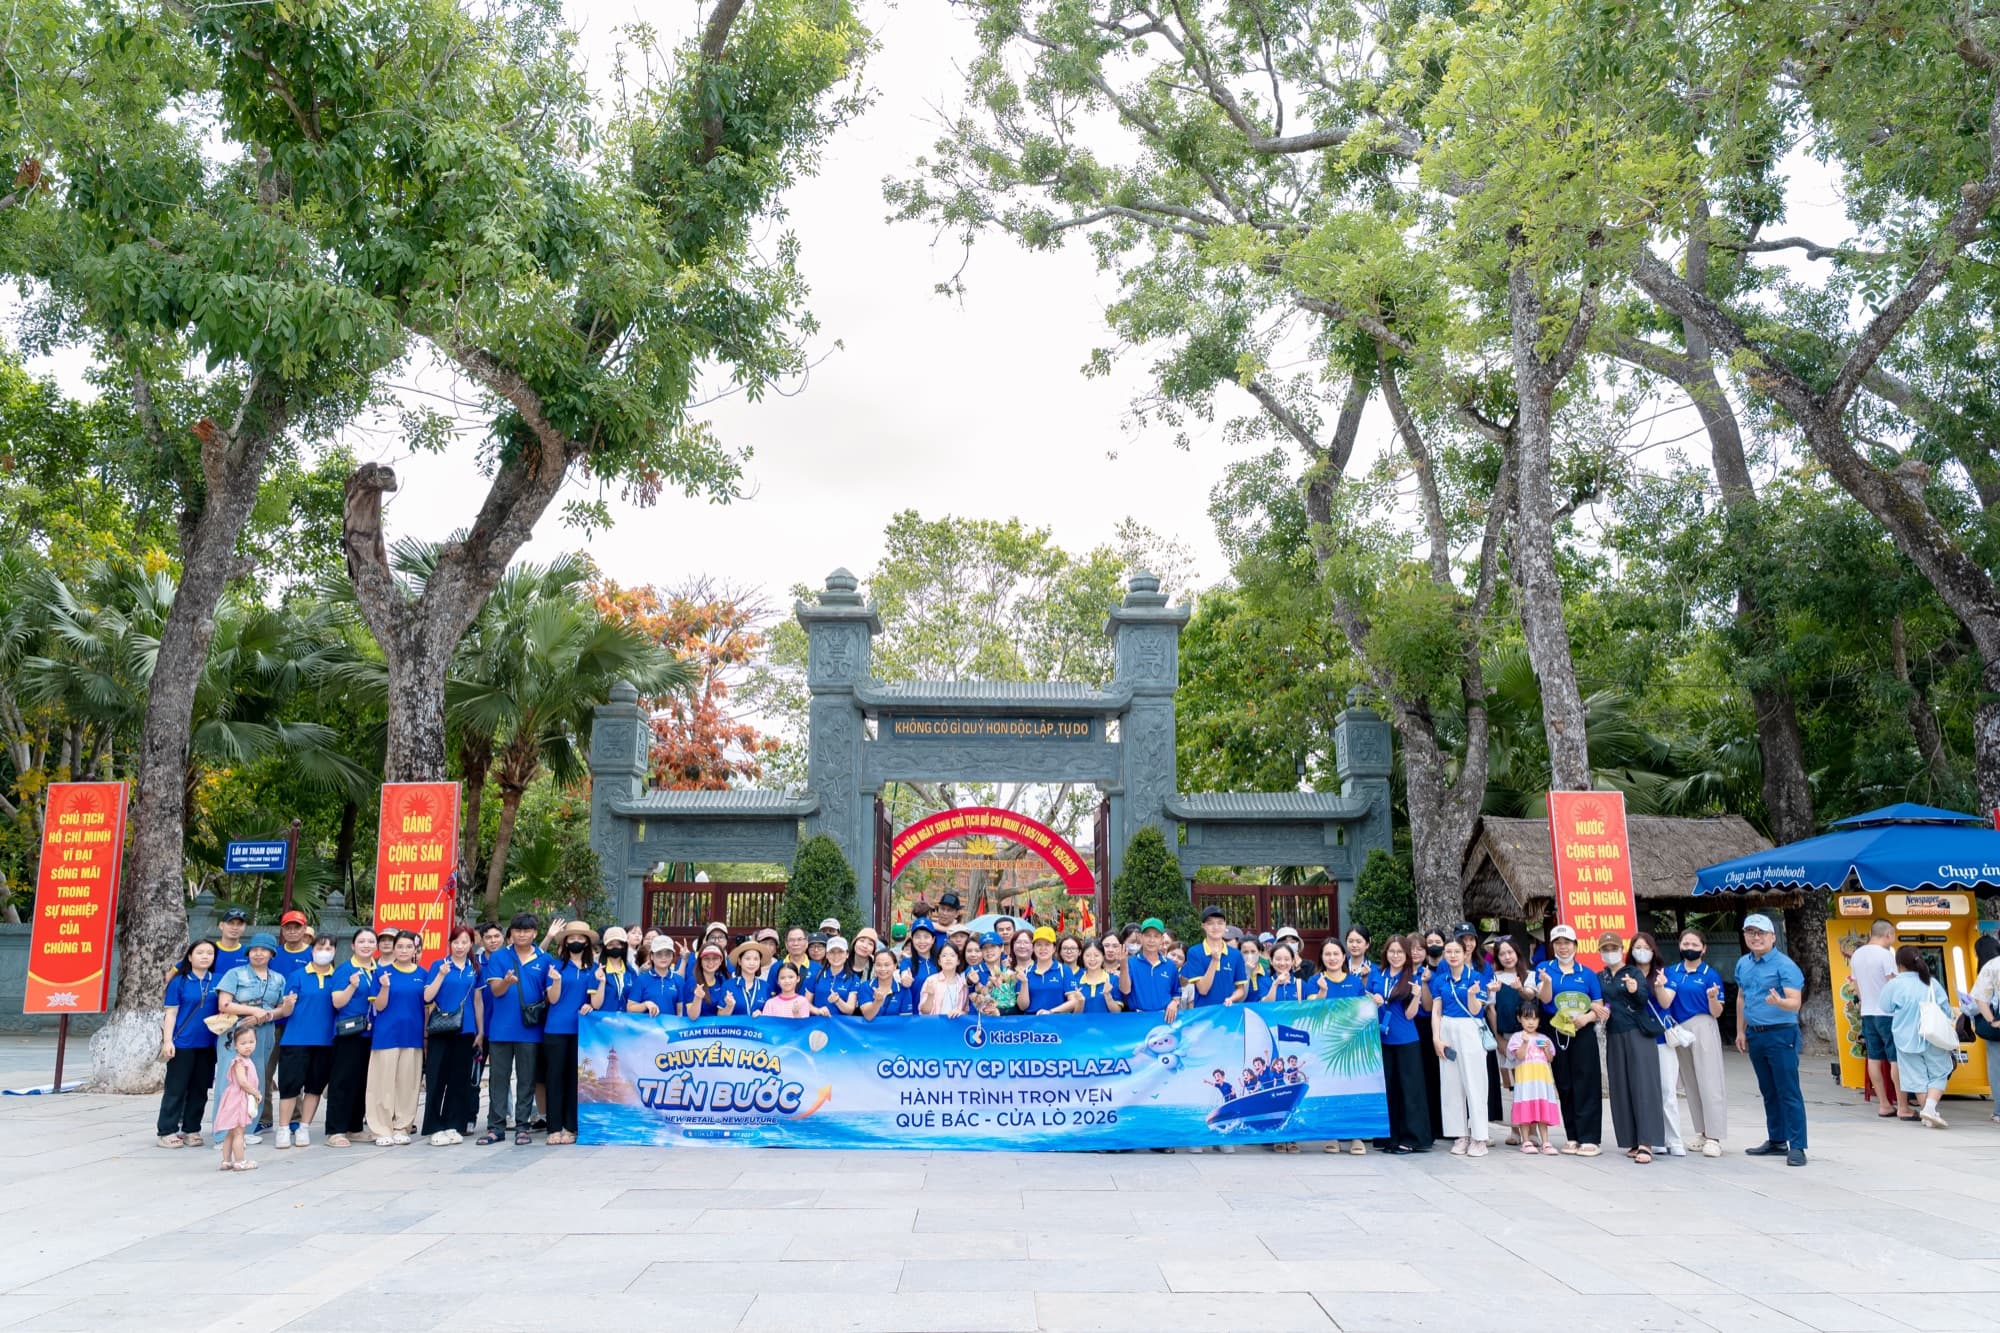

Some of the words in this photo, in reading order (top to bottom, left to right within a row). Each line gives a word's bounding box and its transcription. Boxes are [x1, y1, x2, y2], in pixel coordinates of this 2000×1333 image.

[895, 716, 932, 733] KHÔNG
[933, 717, 948, 734] CÓ
[950, 717, 961, 734] GÌ
[962, 718, 984, 734] QUÝ
[986, 722, 1008, 734] HƠN
[1010, 718, 1032, 738] ĐỘC
[1058, 722, 1072, 738] TỰ
[1073, 722, 1088, 735] DO
[59, 810, 80, 825] CHỦ
[82, 812, 104, 826] TỊCH
[402, 810, 432, 833] ĐẢNG
[1575, 818, 1605, 835] NƯỚC
[64, 829, 82, 843] CHÍ
[84, 830, 111, 843] MINH
[63, 848, 74, 861] VĨ
[75, 849, 92, 863] ĐẠI
[249, 847, 265, 855] THAM
[266, 847, 282, 855] QUAN
[388, 841, 418, 866] CỘNG
[420, 839, 443, 862] SẢN
[1566, 842, 1597, 861] CỘNG
[1598, 842, 1620, 859] HÒA
[50, 864, 78, 880] SỐNG
[80, 864, 100, 879] MÃI
[1577, 863, 1592, 882] XÃ
[1594, 865, 1613, 884] HỘI
[1725, 871, 1745, 883] Chụp
[1745, 866, 1761, 880] ảnh
[1762, 865, 1806, 880] photobooth
[1938, 864, 1979, 880] Chụp
[388, 870, 411, 895] VIỆT
[413, 873, 439, 891] NAM
[57, 886, 90, 898] TRONG
[1568, 887, 1591, 906] CHỦ
[1593, 888, 1627, 906] NGHĨA
[1905, 895, 1940, 906] Newspaper
[45, 903, 61, 919] SỰ
[61, 902, 98, 918] NGHIỆP
[380, 903, 416, 923] QUANG
[418, 902, 444, 920] VINH
[59, 920, 80, 935] CỦA
[1574, 912, 1597, 932] VIỆT
[1599, 914, 1625, 929] NAM
[43, 938, 78, 954] CHÚNG
[80, 941, 92, 953] TA
[420, 928, 441, 950] ĂM
[678, 1030, 701, 1038] TEAM
[702, 1028, 742, 1036] BUILDING
[743, 1030, 763, 1039] 2026
[989, 1031, 1059, 1044] KidsPlaza
[655, 1041, 734, 1070] CHUYỂN
[738, 1049, 781, 1073] HÓA
[878, 1055, 940, 1078] CÔNG
[944, 1059, 971, 1078] TY
[976, 1059, 1004, 1078] CP
[1008, 1058, 1131, 1078] KIDSPLAZA
[638, 1071, 708, 1110] TIẾN
[710, 1076, 803, 1112] BƯỚC
[900, 1088, 953, 1105] HÀNH
[957, 1088, 1013, 1105] TRÌNH
[1018, 1089, 1070, 1107] TRỌN
[1075, 1088, 1113, 1106] VẸN
[744, 1116, 777, 1124] FUTURE
[896, 1110, 935, 1128] QUÊ
[942, 1109, 979, 1127] BÁC
[996, 1108, 1036, 1127] CỬA
[1043, 1108, 1066, 1126] LÒ
[1072, 1110, 1118, 1125] 2026
